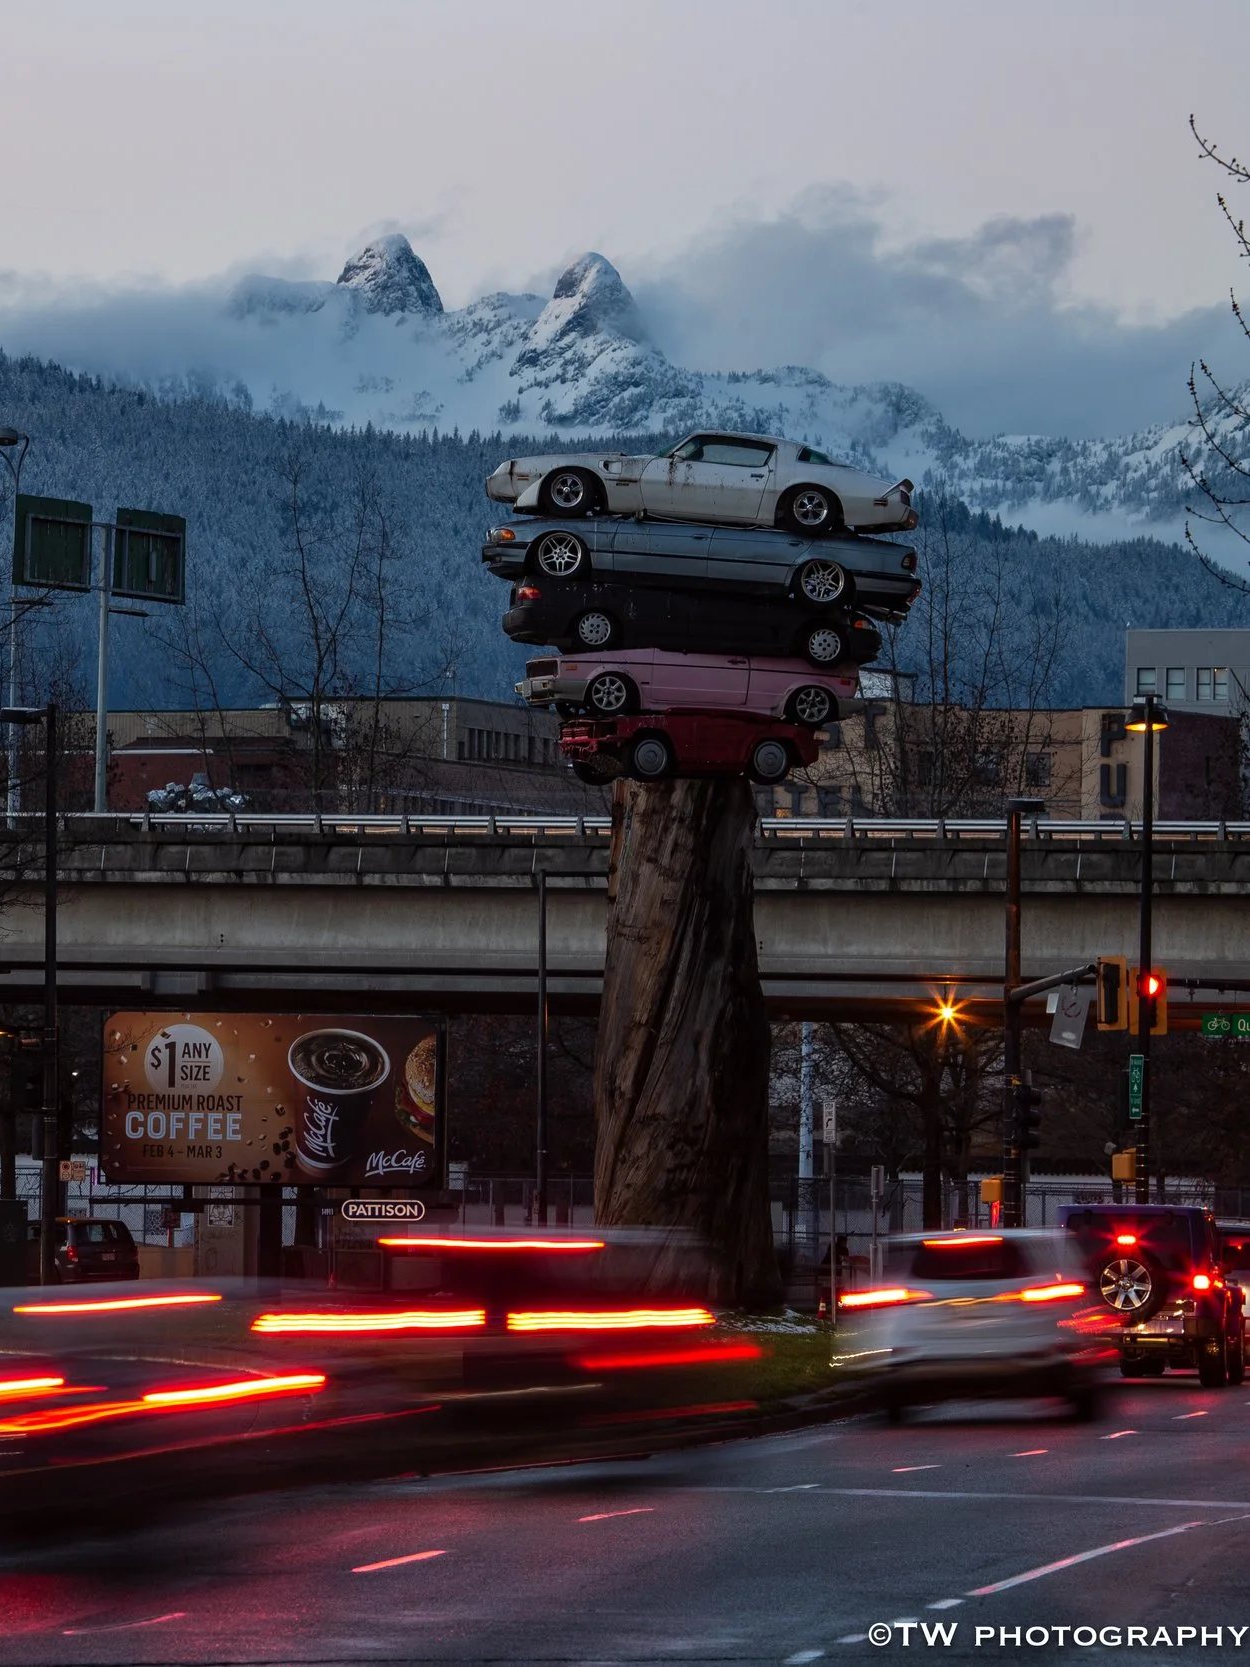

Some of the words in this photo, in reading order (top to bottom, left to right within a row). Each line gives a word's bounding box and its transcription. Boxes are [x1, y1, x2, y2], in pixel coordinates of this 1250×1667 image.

[1100, 713, 1127, 820] PU
[181, 1043, 212, 1059] ANY
[150, 1041, 177, 1088] $1
[180, 1065, 211, 1081] SIZE
[127, 1094, 193, 1111] PREMIUM
[196, 1095, 243, 1112] ROAST
[125, 1111, 242, 1141] COFFEE
[142, 1144, 164, 1158] FEB
[166, 1145, 175, 1158] 4
[186, 1145, 213, 1159] MAR
[215, 1145, 223, 1159] 3
[348, 1204, 419, 1216] PATTISON
